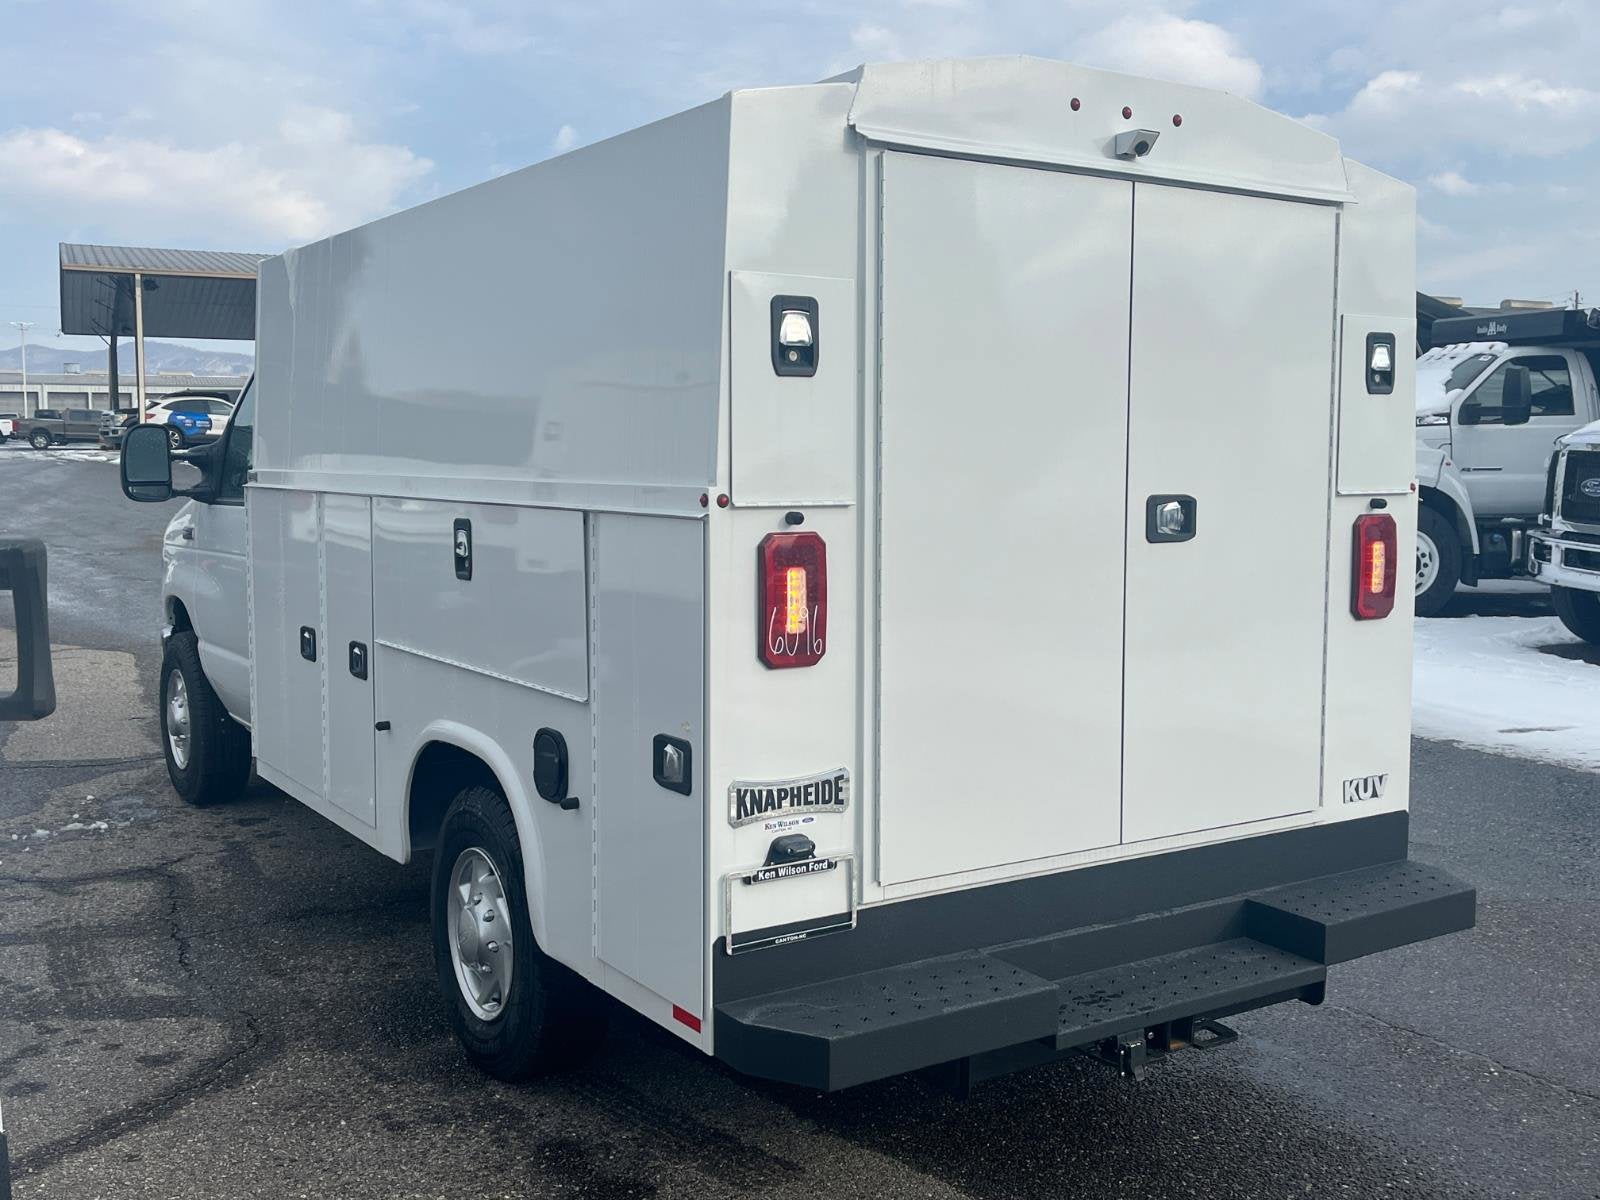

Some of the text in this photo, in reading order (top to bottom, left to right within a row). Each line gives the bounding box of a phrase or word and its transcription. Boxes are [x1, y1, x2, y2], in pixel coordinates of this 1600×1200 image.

[736, 774, 845, 820] KNAPHEIDE
[1342, 773, 1389, 804] KUV
[758, 860, 828, 881] Ken Wilson Ford
